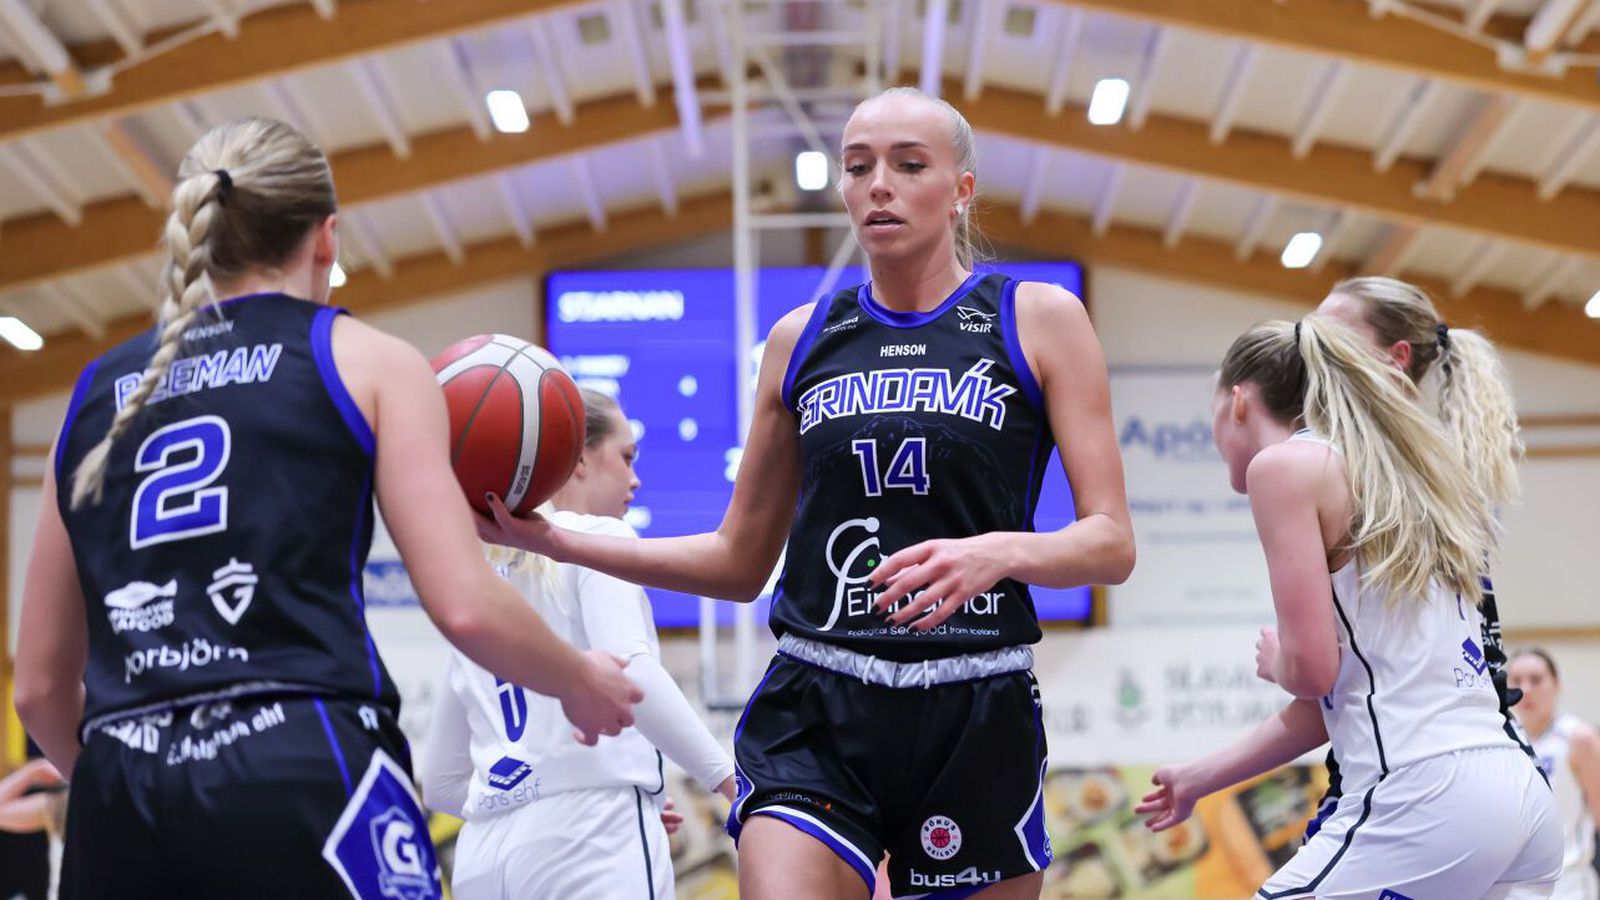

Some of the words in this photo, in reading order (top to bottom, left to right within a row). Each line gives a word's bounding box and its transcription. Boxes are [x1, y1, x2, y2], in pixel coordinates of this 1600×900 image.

[880, 344, 926, 357] HENSON
[130, 415, 231, 550] 2
[852, 437, 930, 497] 14
[382, 820, 422, 875] G
